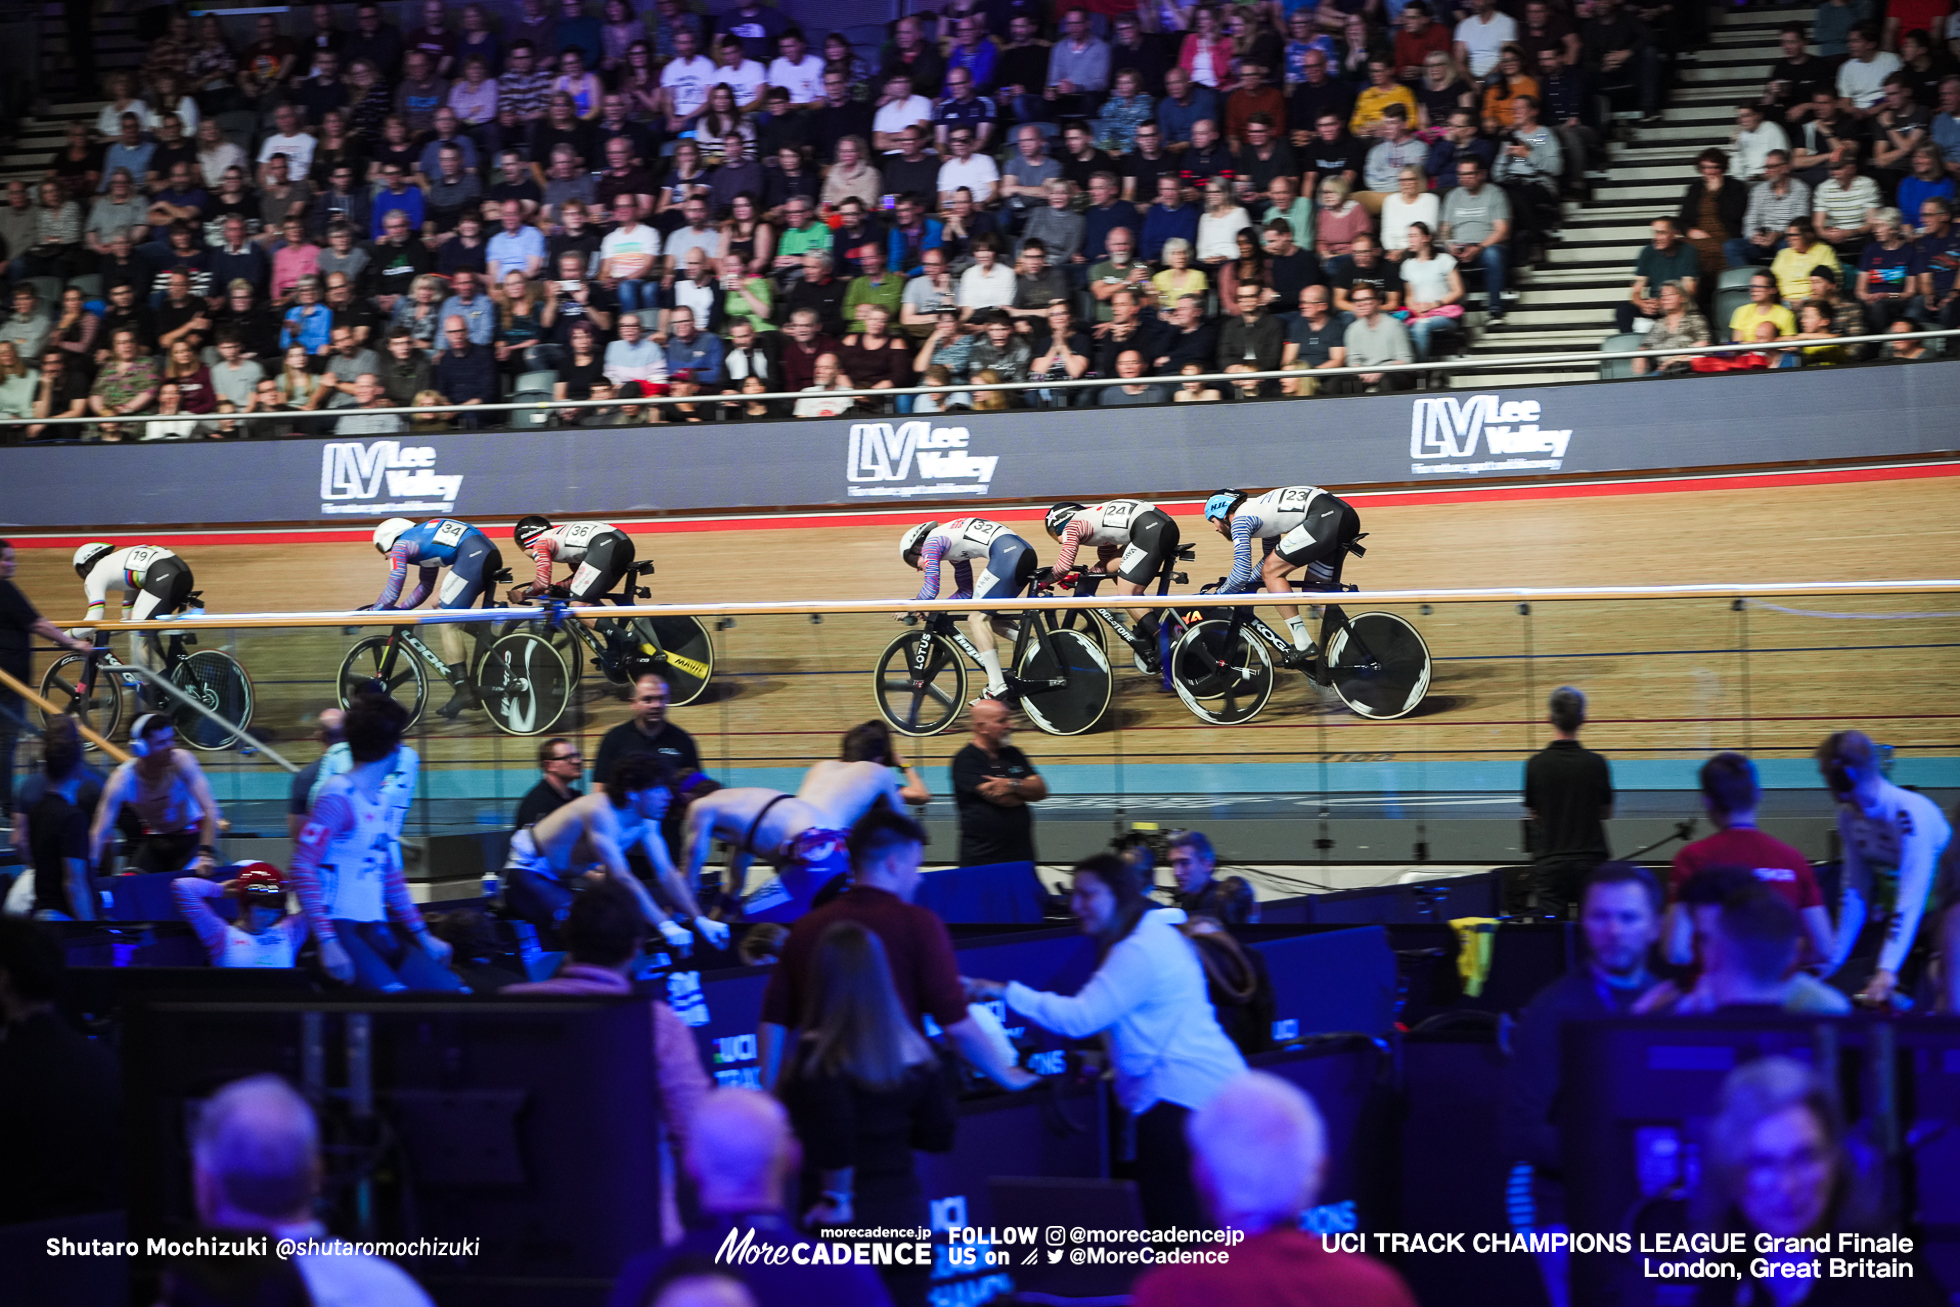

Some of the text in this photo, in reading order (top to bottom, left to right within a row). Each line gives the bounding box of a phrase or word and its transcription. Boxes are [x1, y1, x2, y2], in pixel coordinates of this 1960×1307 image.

[1484, 395, 1541, 423] Lee
[916, 422, 970, 448] Lee
[1484, 424, 1573, 458] Valley
[385, 441, 436, 468] Lee
[916, 450, 999, 482] Valley
[385, 469, 464, 501] Valley
[1286, 490, 1306, 502] 23
[1106, 505, 1125, 516] 24
[441, 523, 462, 537] 34
[571, 525, 589, 537] 36
[973, 520, 994, 535] 32
[133, 551, 148, 562] 19
[401, 629, 451, 676] LOOK
[914, 633, 932, 670] LOTUS
